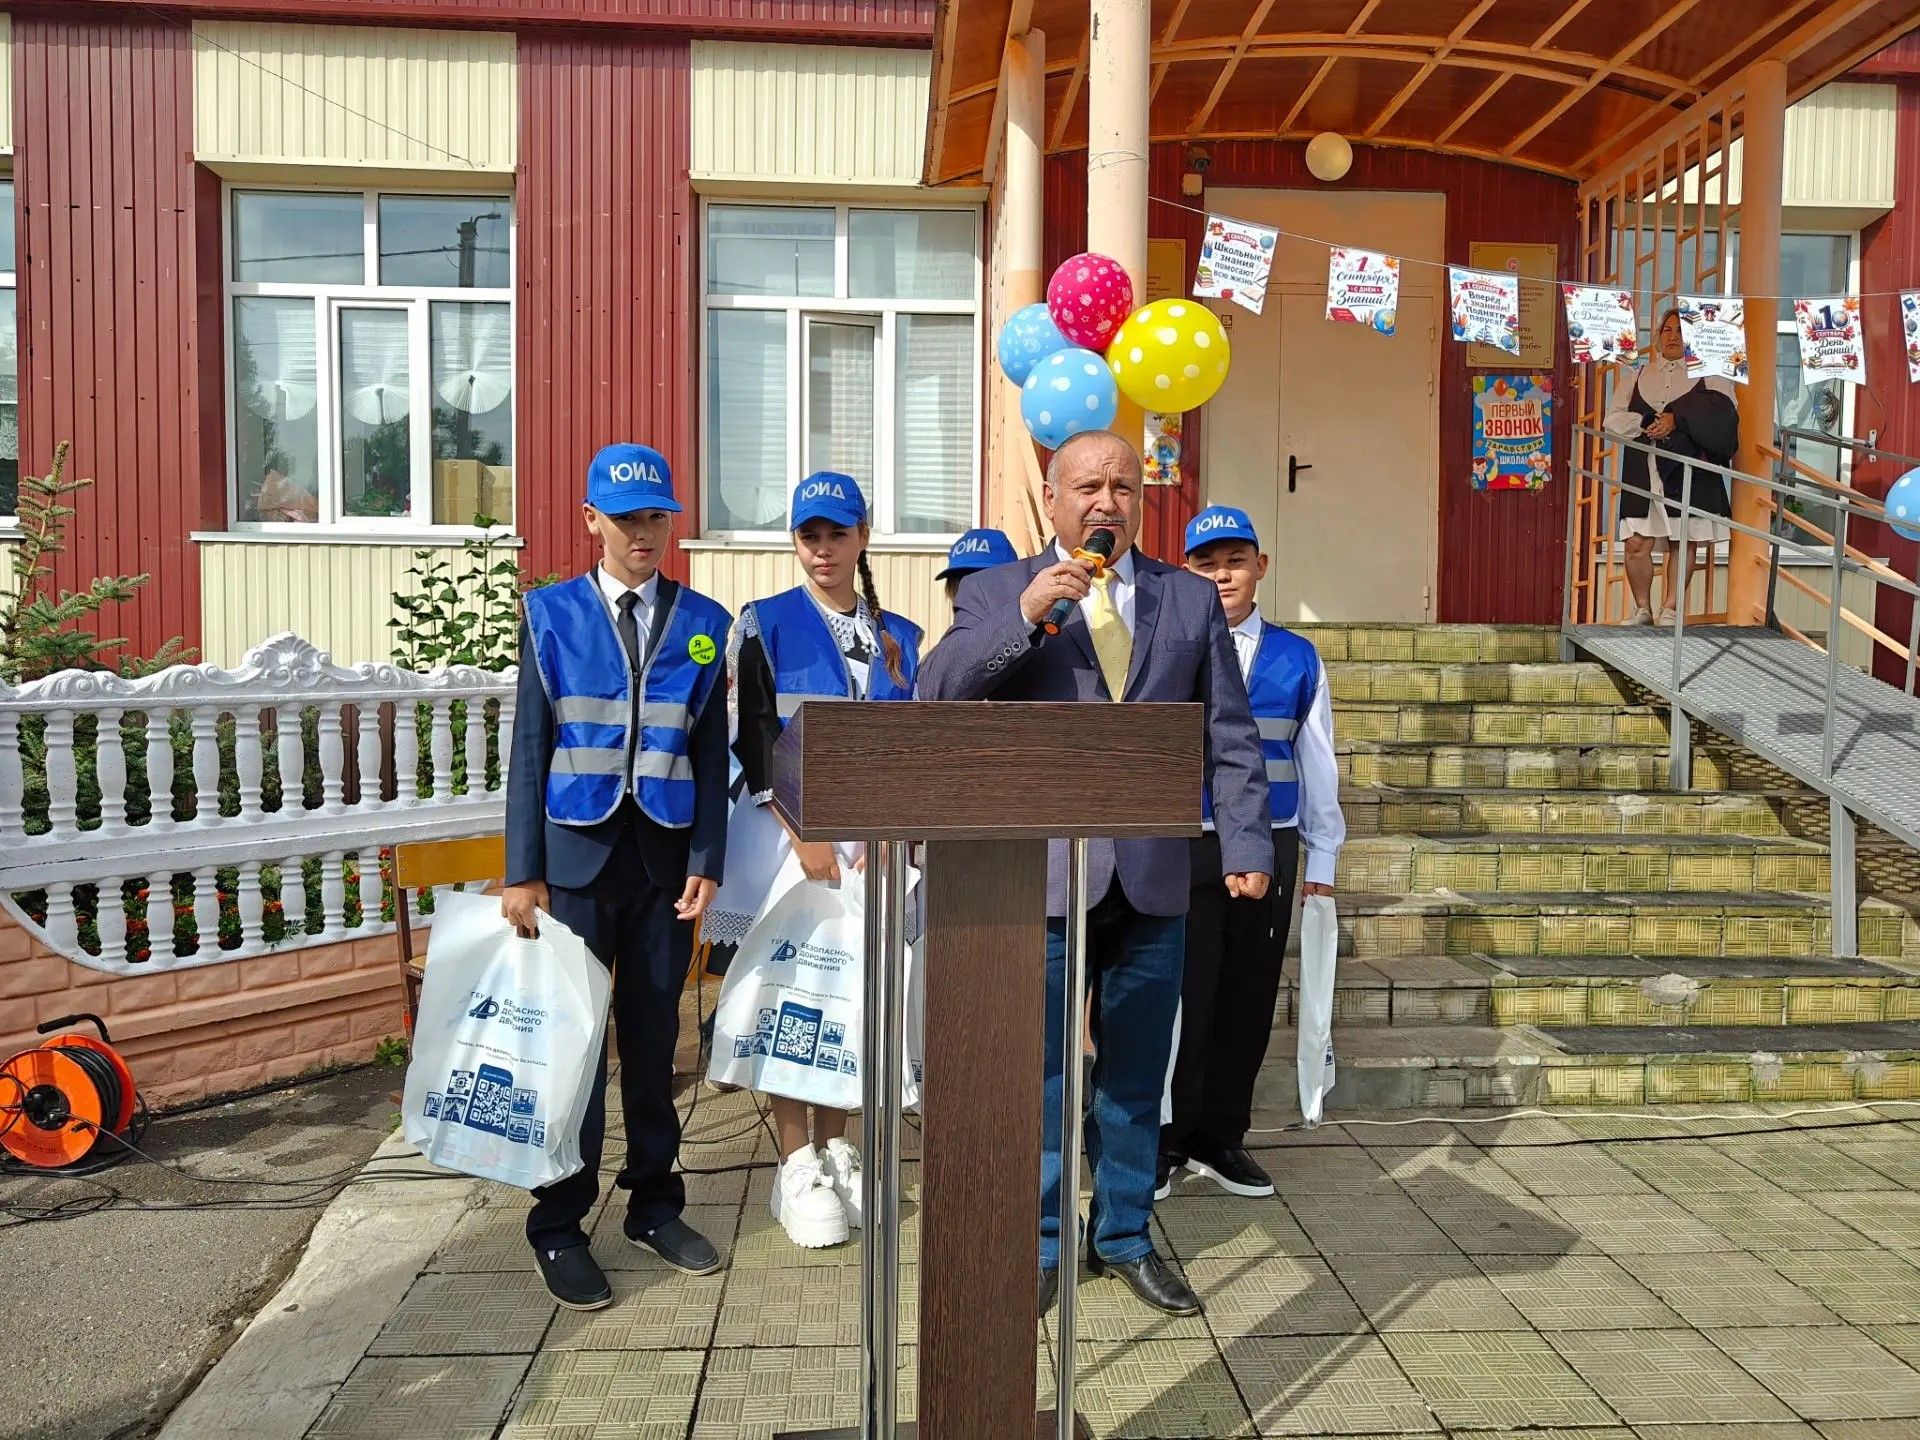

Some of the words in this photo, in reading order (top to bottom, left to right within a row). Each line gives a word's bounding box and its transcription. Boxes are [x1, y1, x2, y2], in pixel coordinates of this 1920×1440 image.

[1214, 242, 1262, 261] Школьные
[1215, 261, 1254, 277] помогают
[1220, 254, 1254, 269] знания
[1356, 256, 1368, 272] 1
[1214, 270, 1228, 279] всю
[1230, 275, 1253, 286] жизнь
[1336, 289, 1391, 306] Знаний!
[1466, 306, 1505, 320] Поднять
[1471, 300, 1510, 313] знаниям!
[1470, 314, 1502, 326] паруса!
[1814, 344, 1853, 358] Знаний!
[1819, 338, 1844, 348] День
[1491, 401, 1535, 418] ПЕРВЫЙ
[1485, 417, 1542, 436] ЗВОНОК
[609, 461, 662, 484] ЮИД
[802, 482, 845, 501] ЮИД
[1195, 515, 1238, 535] ЮИД
[952, 538, 990, 557] ЮИД
[694, 639, 701, 648] Я
[797, 958, 840, 972] ДВИЖЕНИЯ
[798, 950, 847, 966] ДОРОЖНОГО
[470, 991, 485, 999] ГБУ
[501, 1008, 542, 1026] ДОЖНОГО
